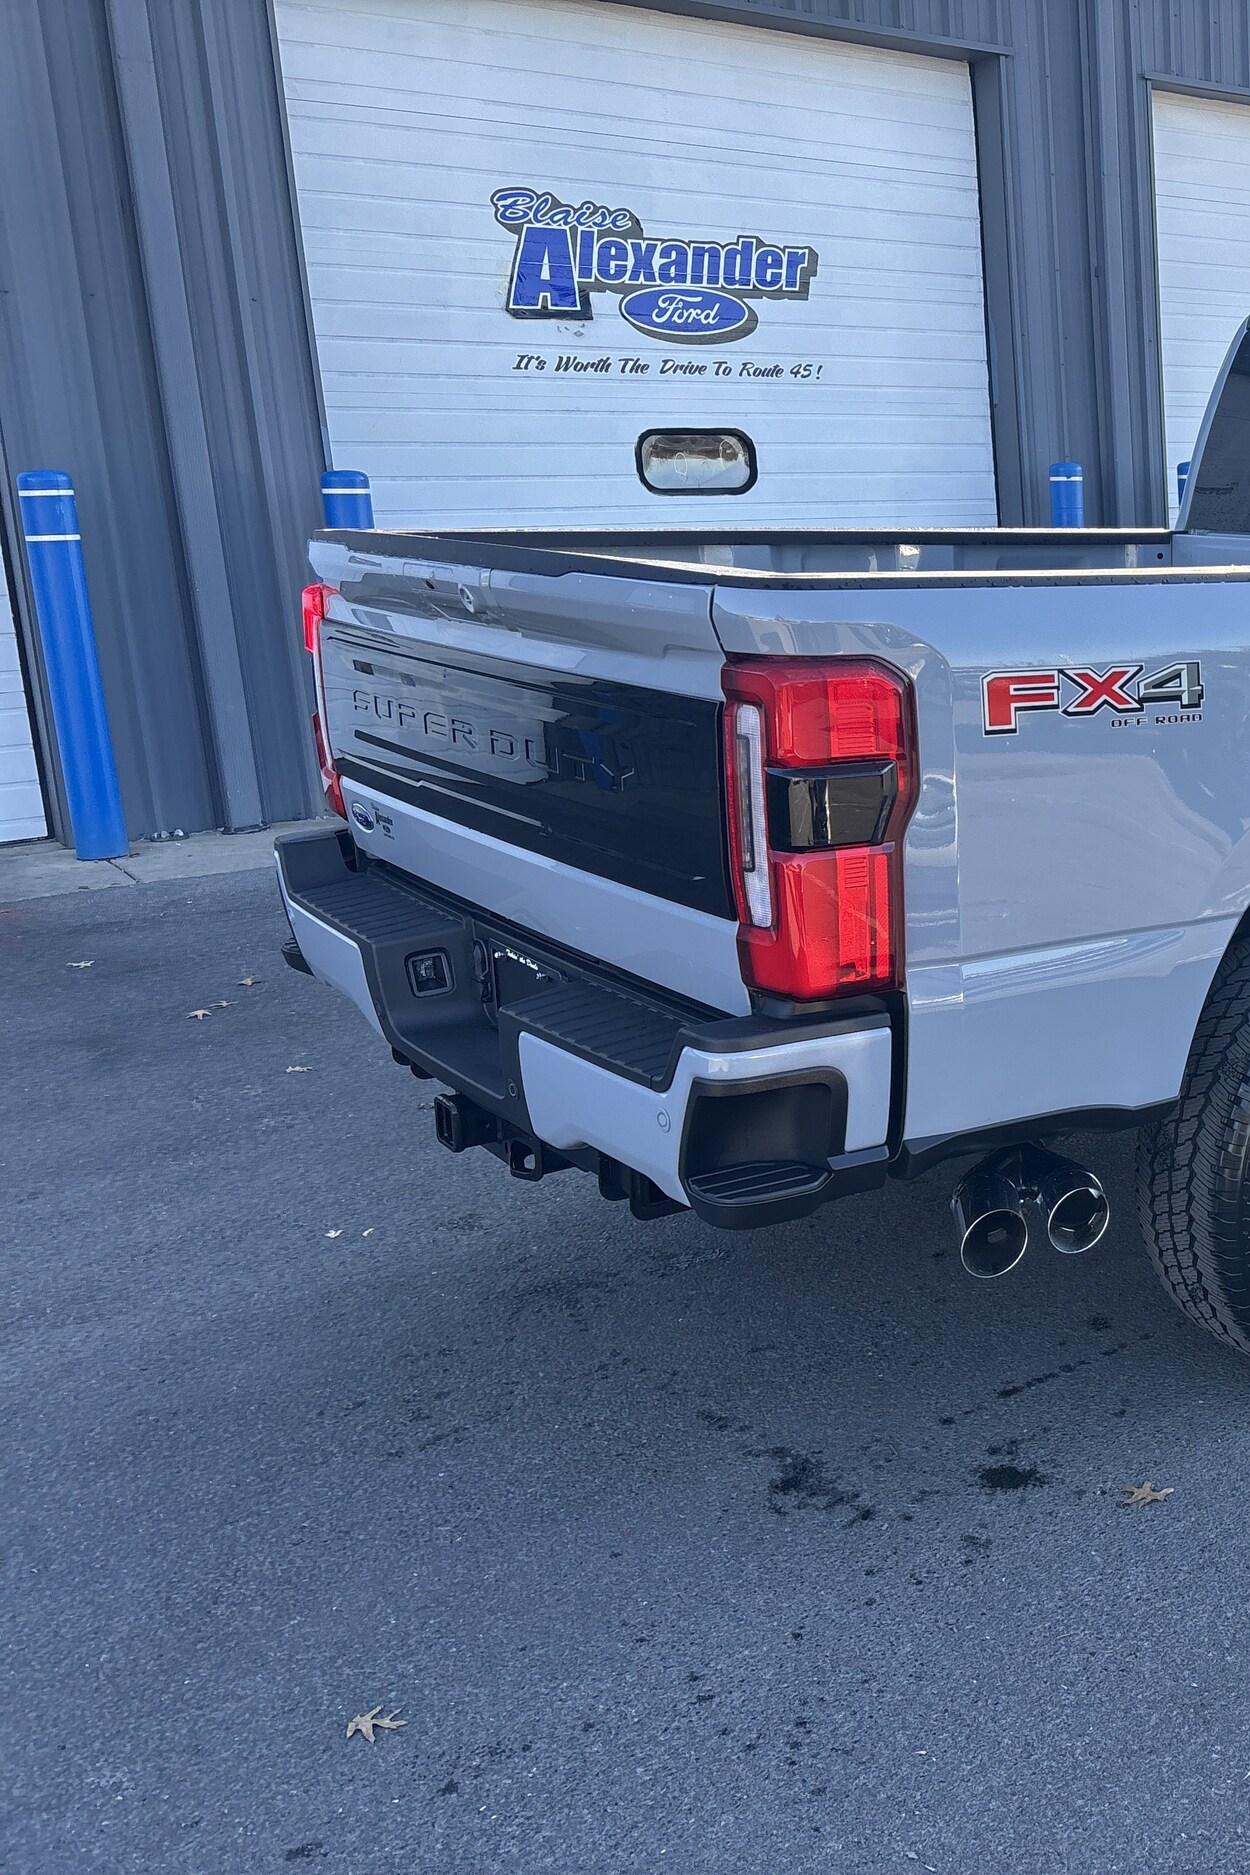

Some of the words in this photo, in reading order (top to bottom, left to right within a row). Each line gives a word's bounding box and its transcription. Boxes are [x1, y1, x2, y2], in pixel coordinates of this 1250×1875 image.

[493, 189, 633, 231] Blaise
[508, 223, 809, 311] Alexander
[651, 293, 720, 326] Ford
[512, 354, 547, 371] It's
[554, 355, 611, 374] Worth
[618, 357, 650, 375] The
[659, 358, 708, 376] Drive
[712, 361, 733, 378] To
[738, 361, 785, 379] Route
[980, 660, 1204, 736] FX4
[352, 688, 479, 749] SUPER
[490, 728, 635, 793] DUTY
[1110, 717, 1148, 728] OFF
[1154, 713, 1203, 726] ROAD
